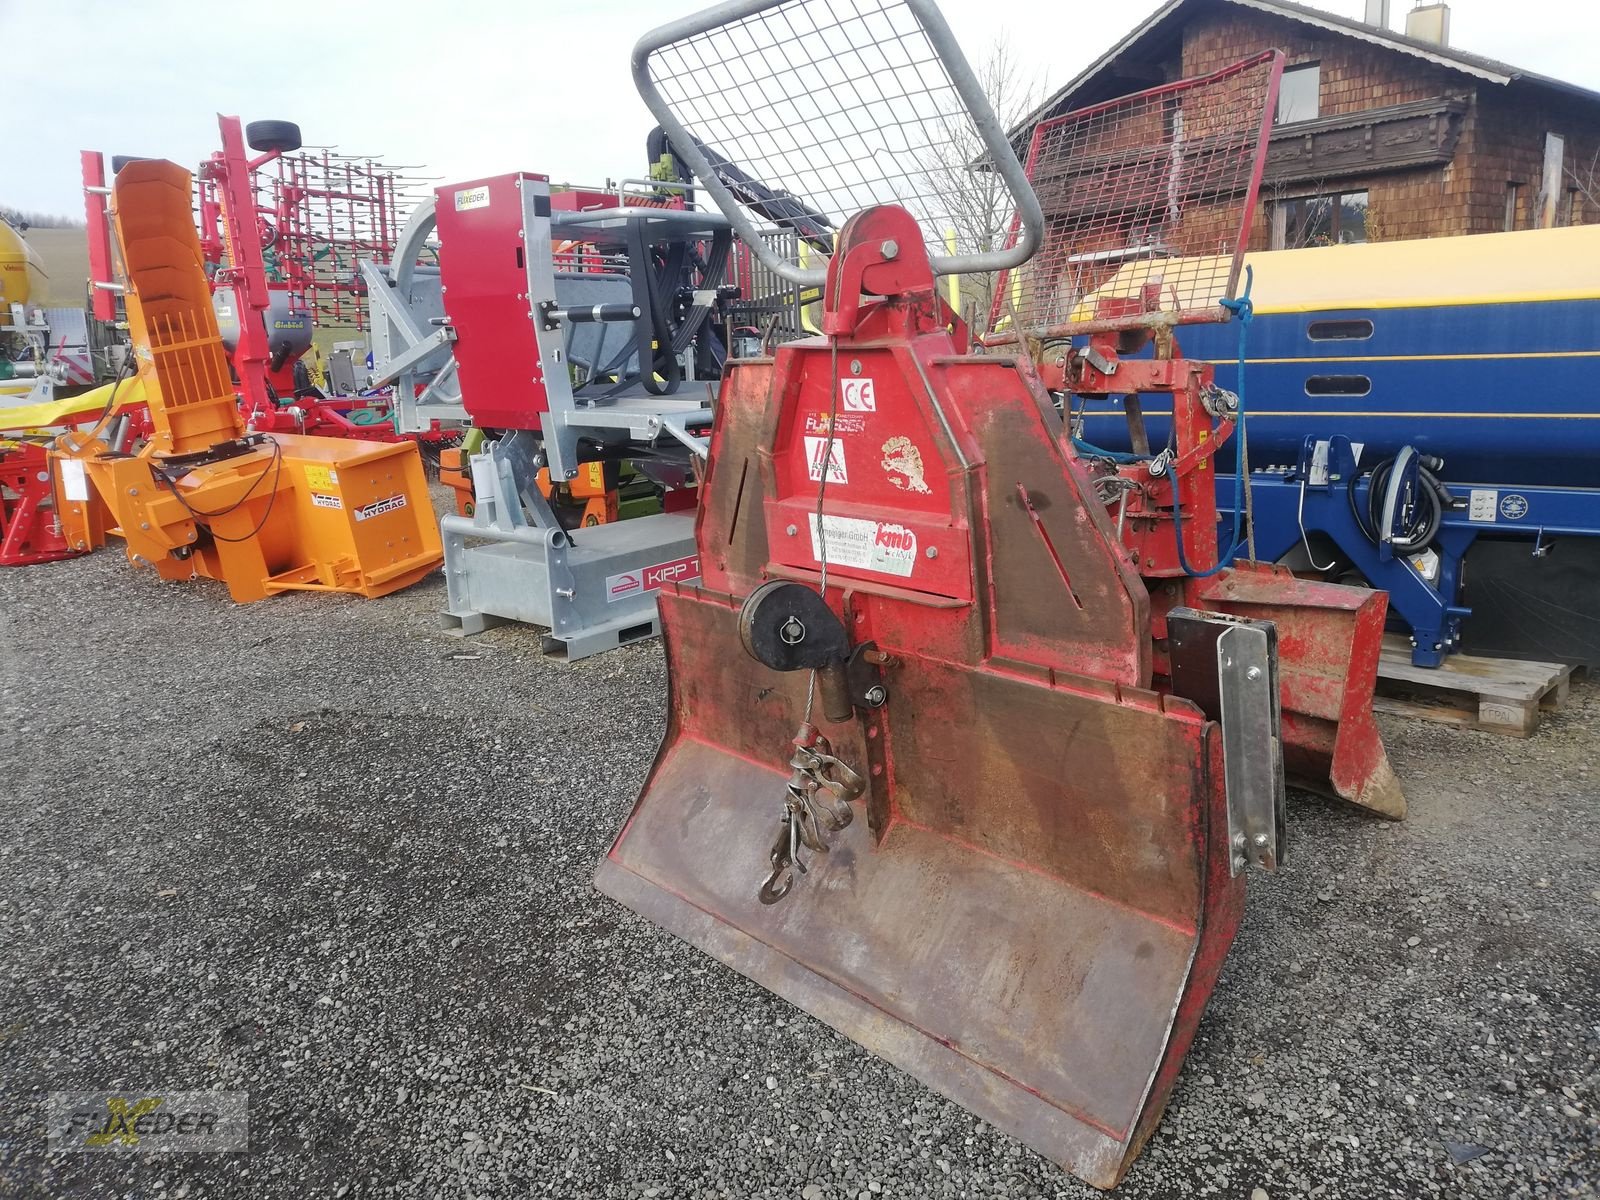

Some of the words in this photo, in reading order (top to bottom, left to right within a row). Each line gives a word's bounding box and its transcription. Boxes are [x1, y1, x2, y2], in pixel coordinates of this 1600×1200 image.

[317, 499, 341, 508] HYDRAC
[364, 500, 405, 518] HYDRAC
[648, 564, 687, 585] KIPP
